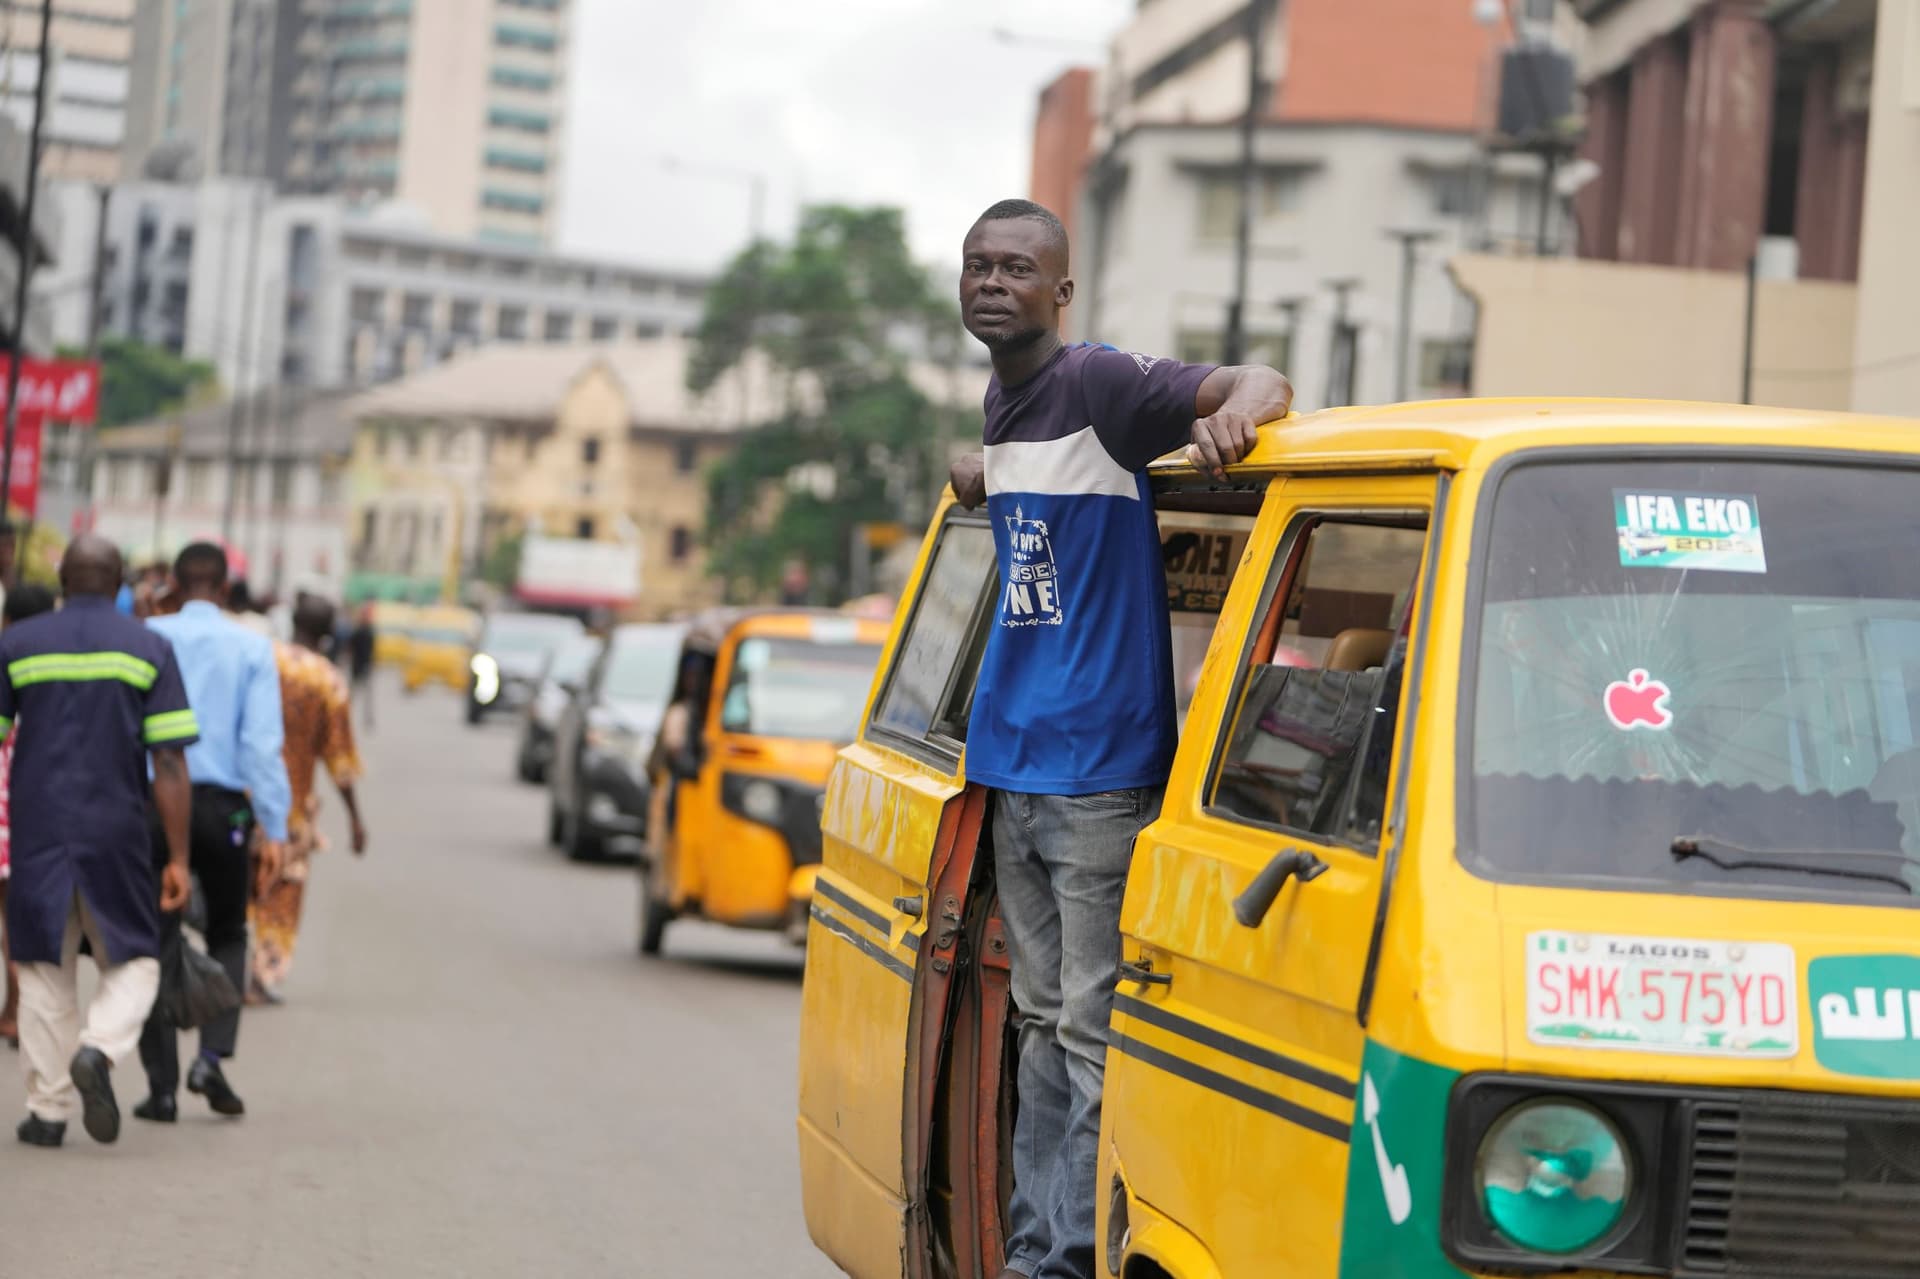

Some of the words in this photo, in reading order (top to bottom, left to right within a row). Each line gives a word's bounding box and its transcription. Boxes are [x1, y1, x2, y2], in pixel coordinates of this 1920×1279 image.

[1624, 495, 1681, 531] IFA
[1684, 497, 1752, 534] EKO
[1608, 942, 1712, 960] LAGOS
